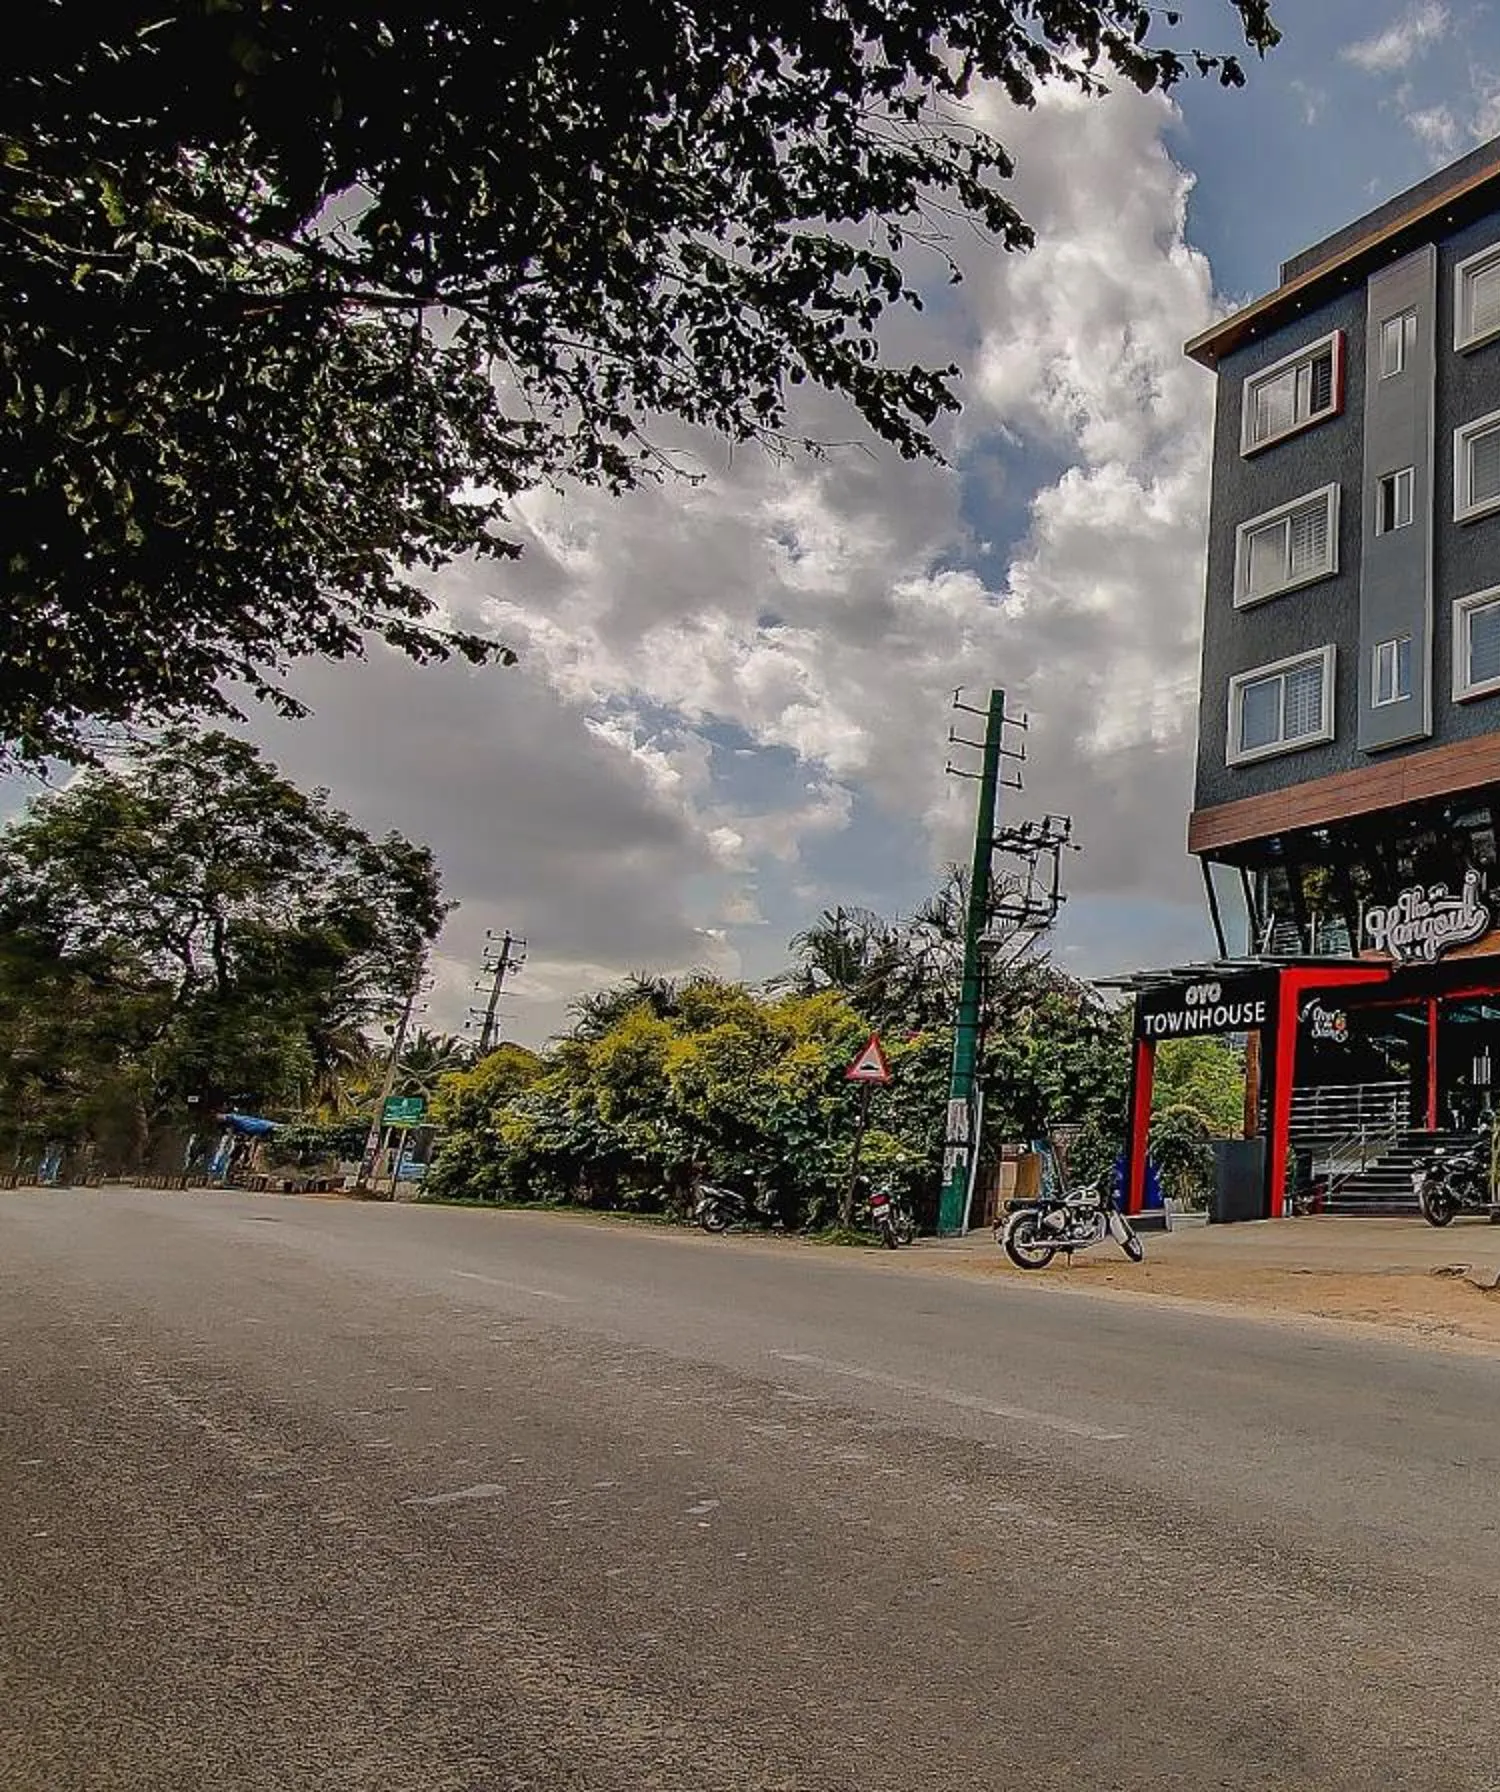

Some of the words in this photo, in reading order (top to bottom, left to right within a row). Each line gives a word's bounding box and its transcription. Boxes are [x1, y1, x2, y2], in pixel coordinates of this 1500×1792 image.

[1365, 872, 1487, 962] Hangout
[1398, 885, 1432, 922] The
[1185, 982, 1222, 1006] OYO
[1143, 1001, 1265, 1035] TOWNHOUSE
